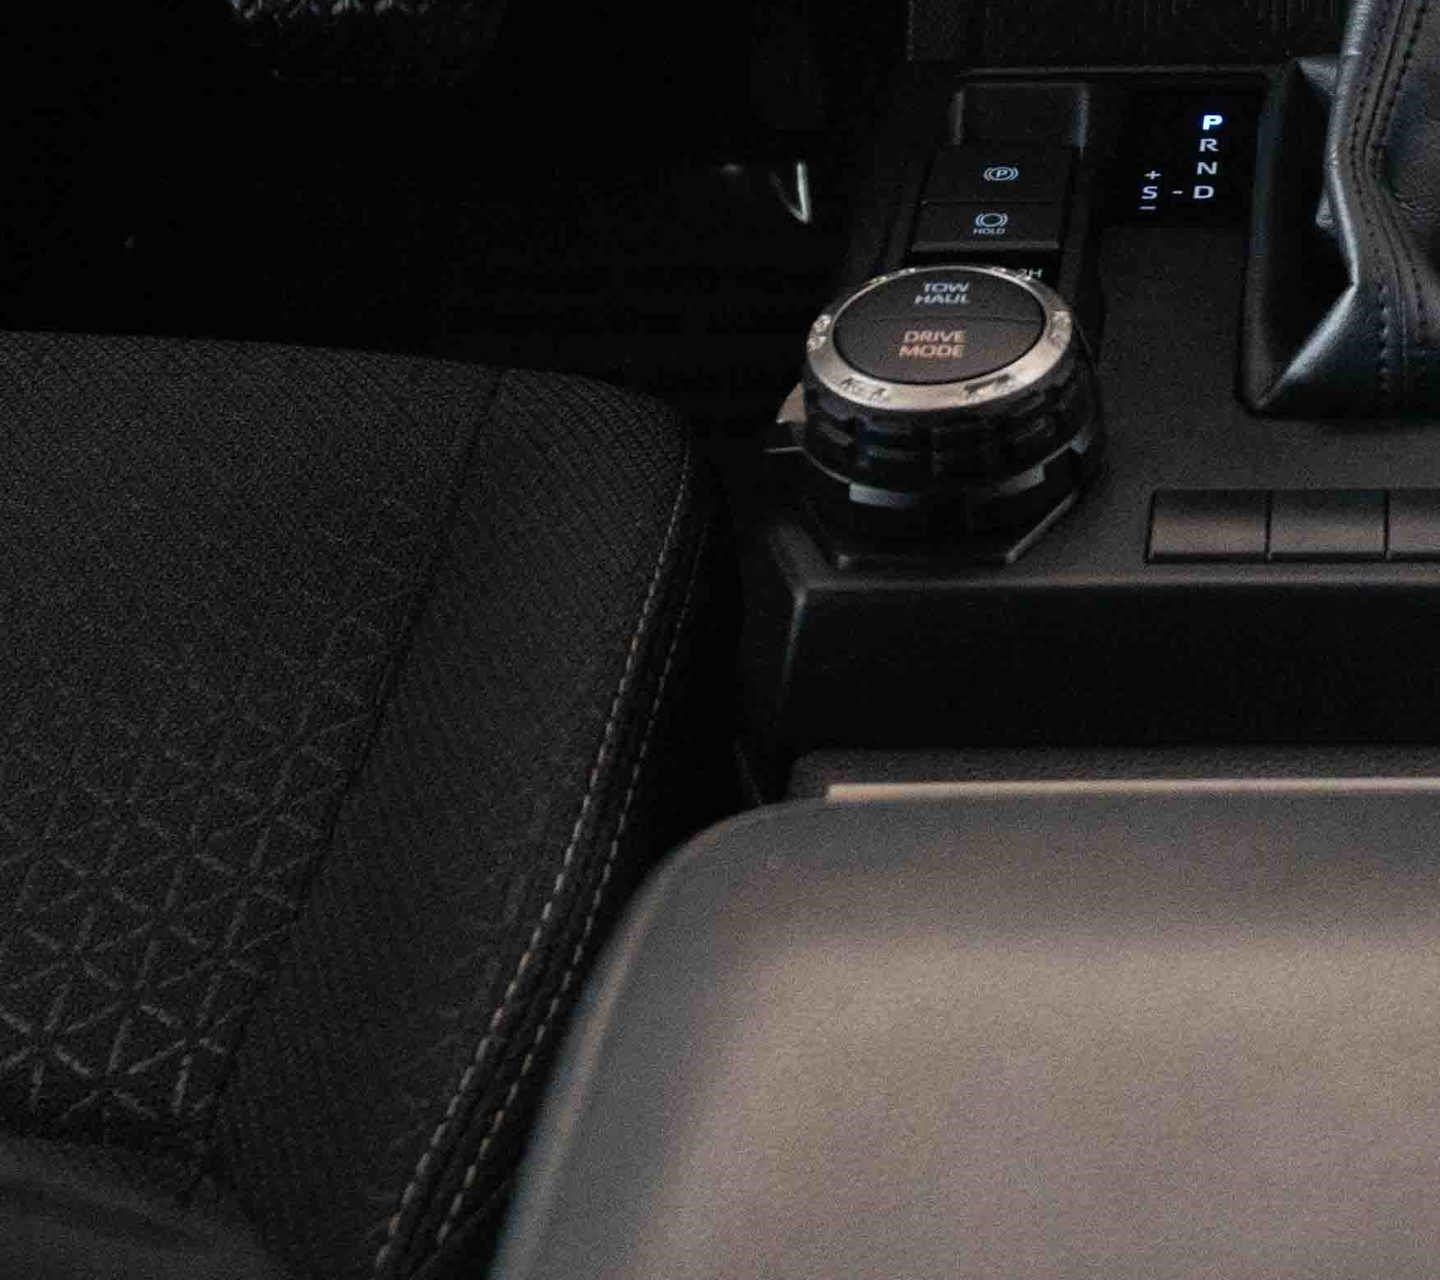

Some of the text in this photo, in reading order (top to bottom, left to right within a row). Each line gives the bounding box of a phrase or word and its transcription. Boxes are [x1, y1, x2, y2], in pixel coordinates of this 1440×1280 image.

[1202, 114, 1223, 130] P
[1199, 138, 1220, 152] R
[1197, 161, 1218, 175] N
[1141, 185, 1215, 200] S D
[973, 227, 1006, 235] HOLD
[924, 282, 969, 293] TOW
[914, 293, 969, 304] HAUL
[903, 330, 967, 343] DRIVE
[899, 344, 965, 359] MODE
